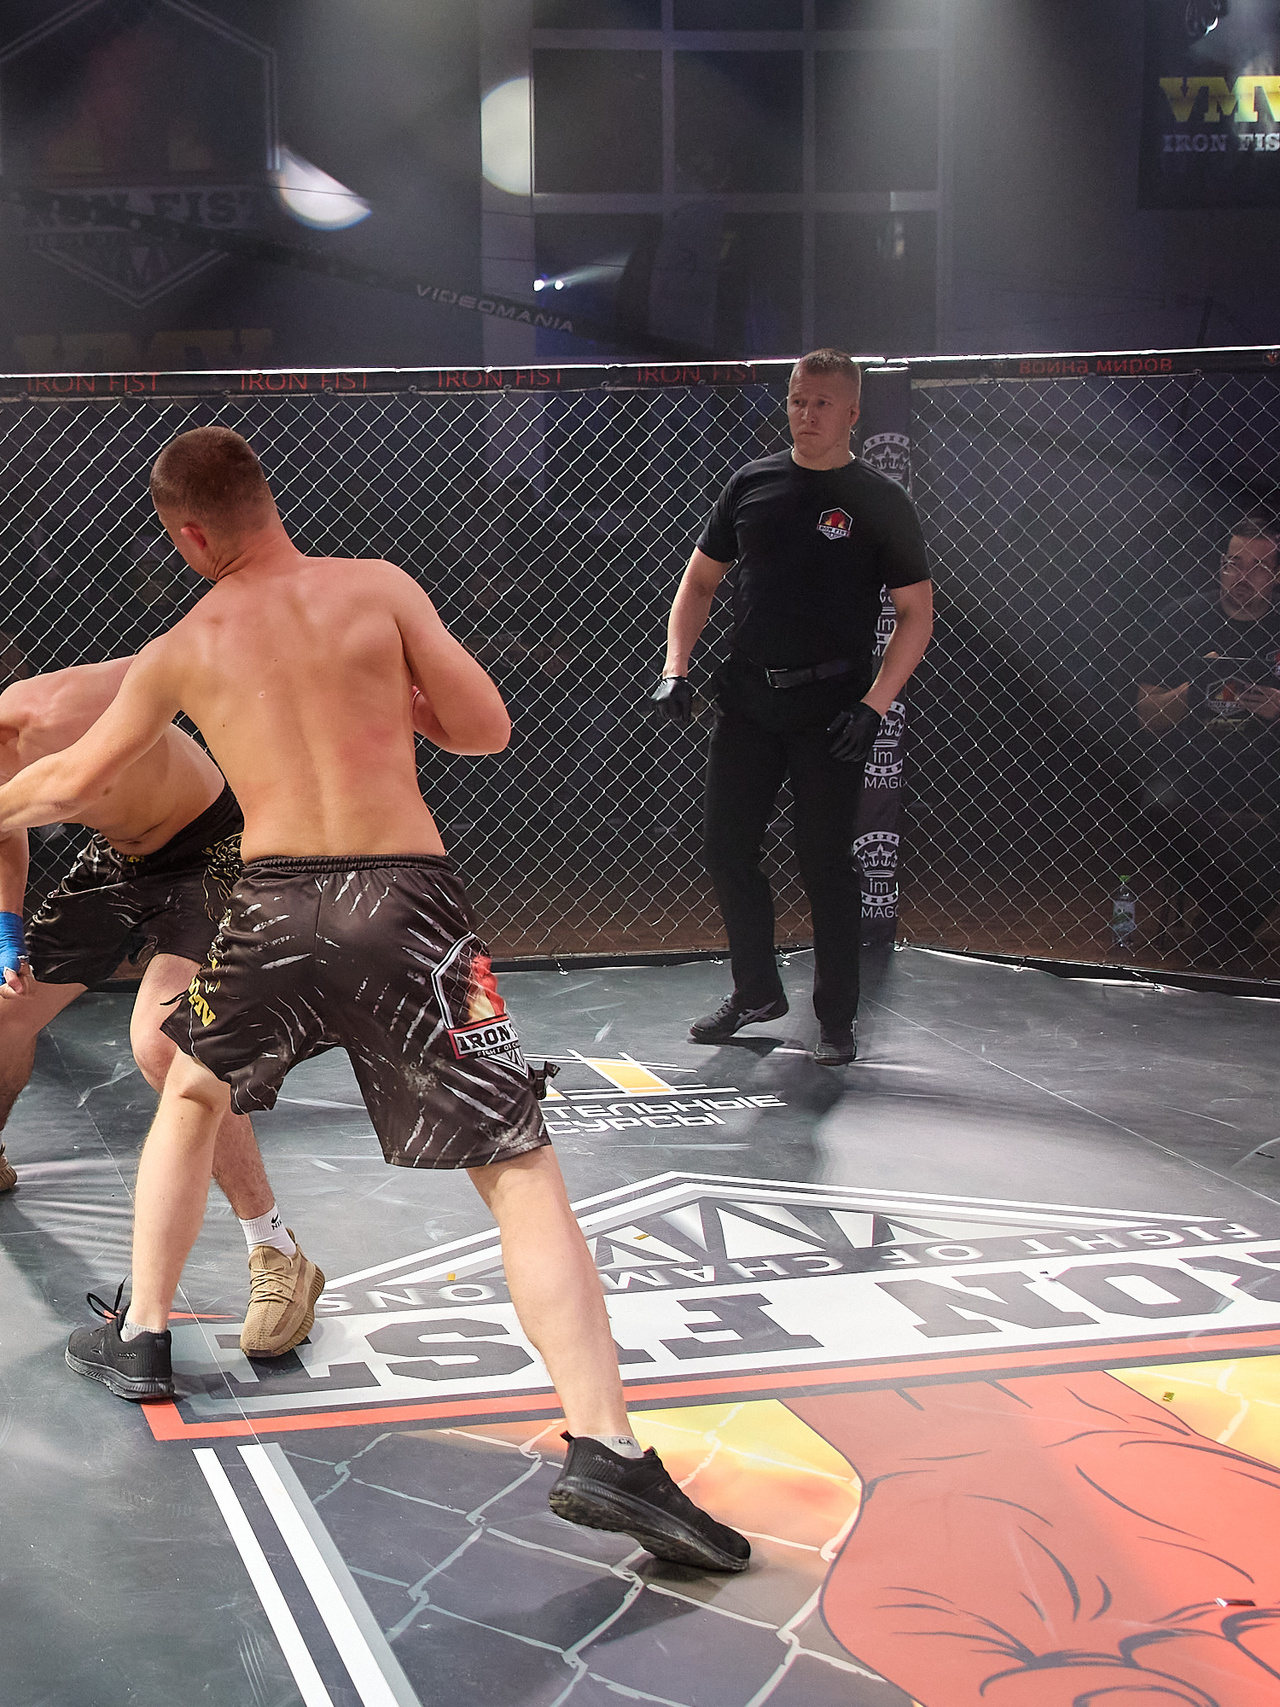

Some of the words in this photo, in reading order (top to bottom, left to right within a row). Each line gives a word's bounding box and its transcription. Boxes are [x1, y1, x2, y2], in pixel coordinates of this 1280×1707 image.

[1163, 134, 1228, 152] IRON
[1238, 133, 1280, 151] FIS
[416, 284, 574, 332] VIDEOMANIA
[26, 373, 96, 393] IRON
[108, 373, 160, 393] FIST
[240, 373, 308, 391] IRON
[437, 369, 503, 388] IRON
[515, 368, 564, 387] FIST
[637, 365, 701, 383] IRON
[873, 747, 893, 764] im
[869, 878, 889, 894] im
[457, 1024, 511, 1051] IRON
[540, 1094, 788, 1120] ТЕЛЬНЫЕ
[546, 1112, 727, 1135] СУРСЫ
[1022, 1223, 1262, 1256] FIGHT
[881, 1244, 984, 1266] OF
[315, 1256, 845, 1313] CHAMONS
[874, 1250, 1280, 1338] RON
